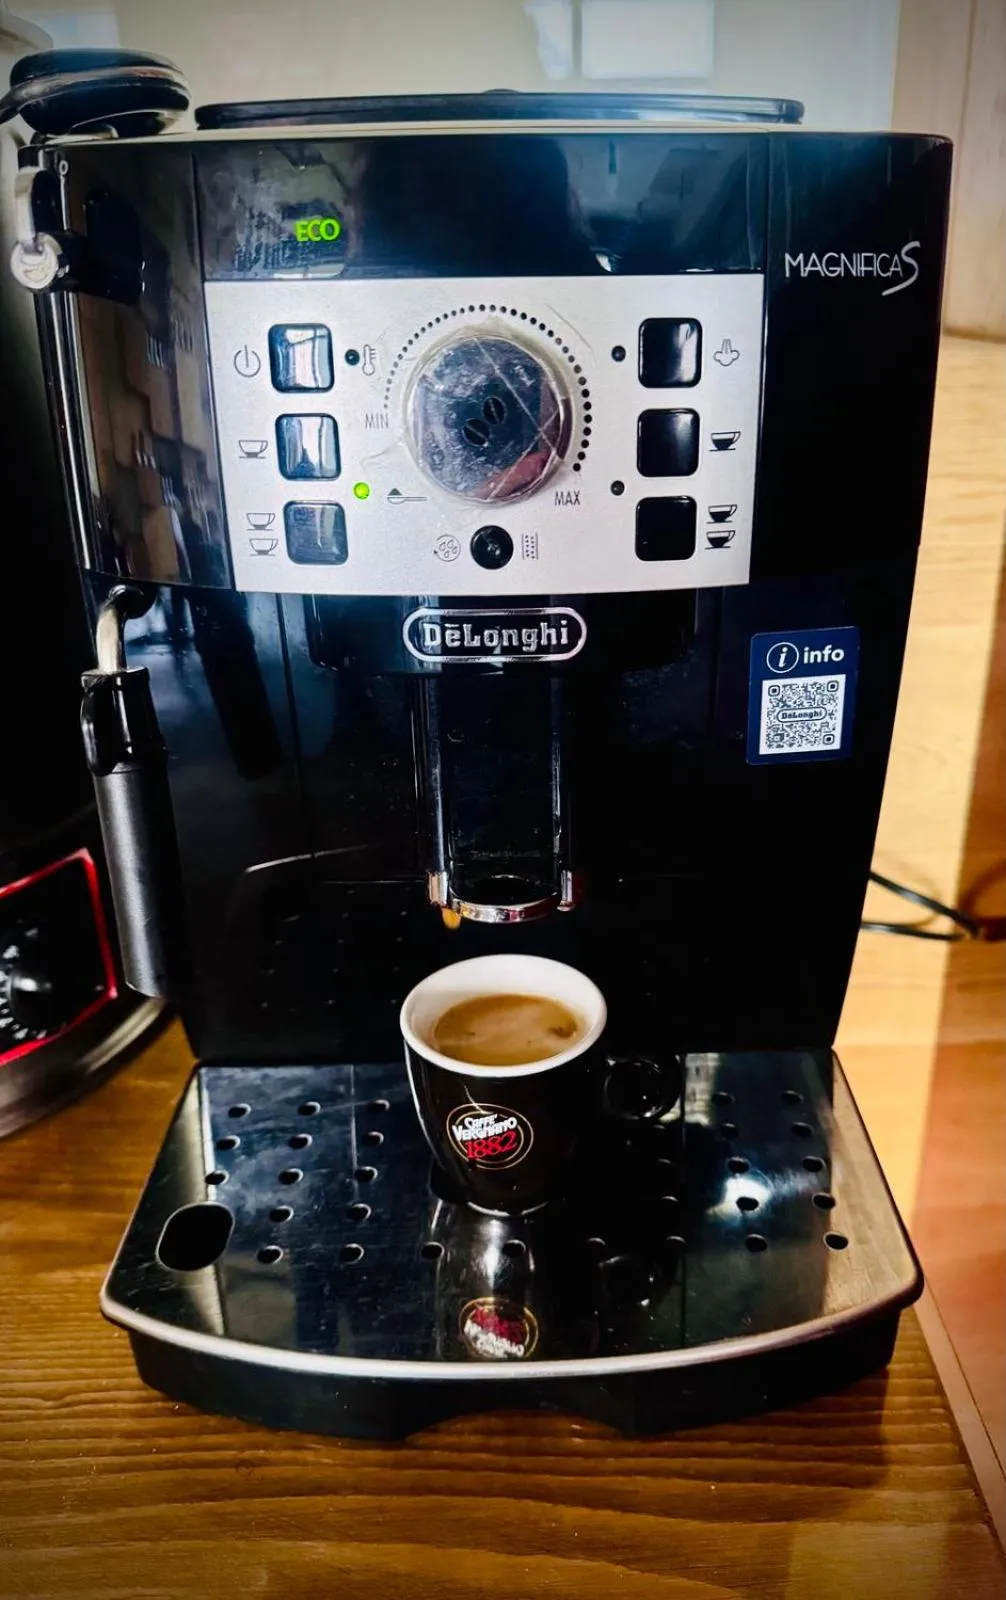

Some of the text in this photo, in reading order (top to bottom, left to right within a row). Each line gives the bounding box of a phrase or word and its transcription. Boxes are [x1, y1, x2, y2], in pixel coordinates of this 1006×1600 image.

[294, 217, 341, 242] ECO
[364, 413, 389, 430] MIN
[554, 490, 581, 506] MAX
[803, 644, 845, 665] info
[465, 1130, 518, 1158] 1882
